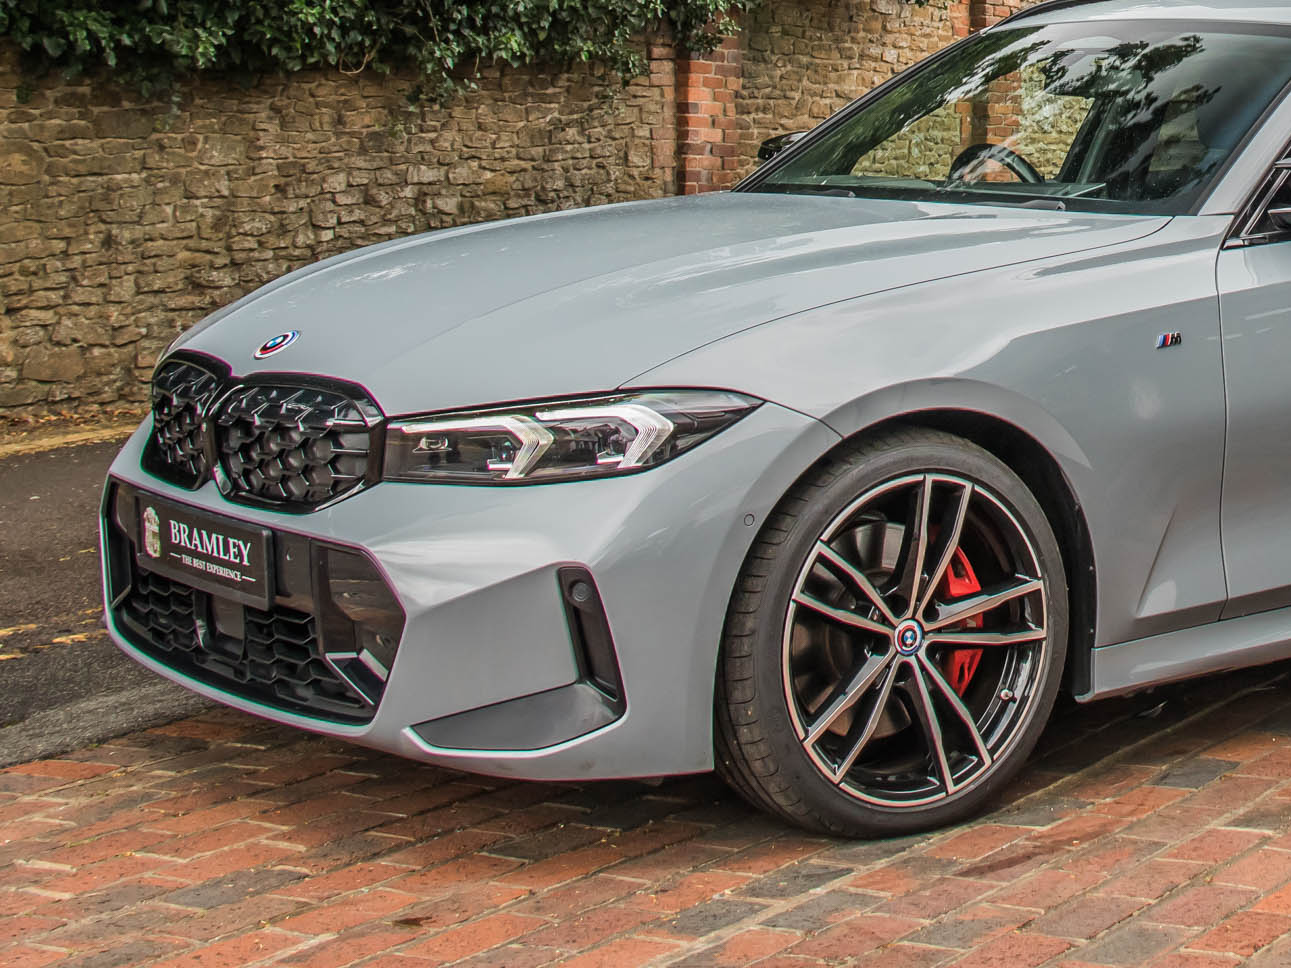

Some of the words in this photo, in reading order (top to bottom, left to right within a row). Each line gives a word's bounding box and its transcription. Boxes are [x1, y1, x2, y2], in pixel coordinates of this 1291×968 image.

[169, 519, 251, 566] BRAMLEY
[181, 554, 192, 566] THE
[193, 558, 206, 571] BEST
[206, 562, 241, 581] EXPERIENCE
